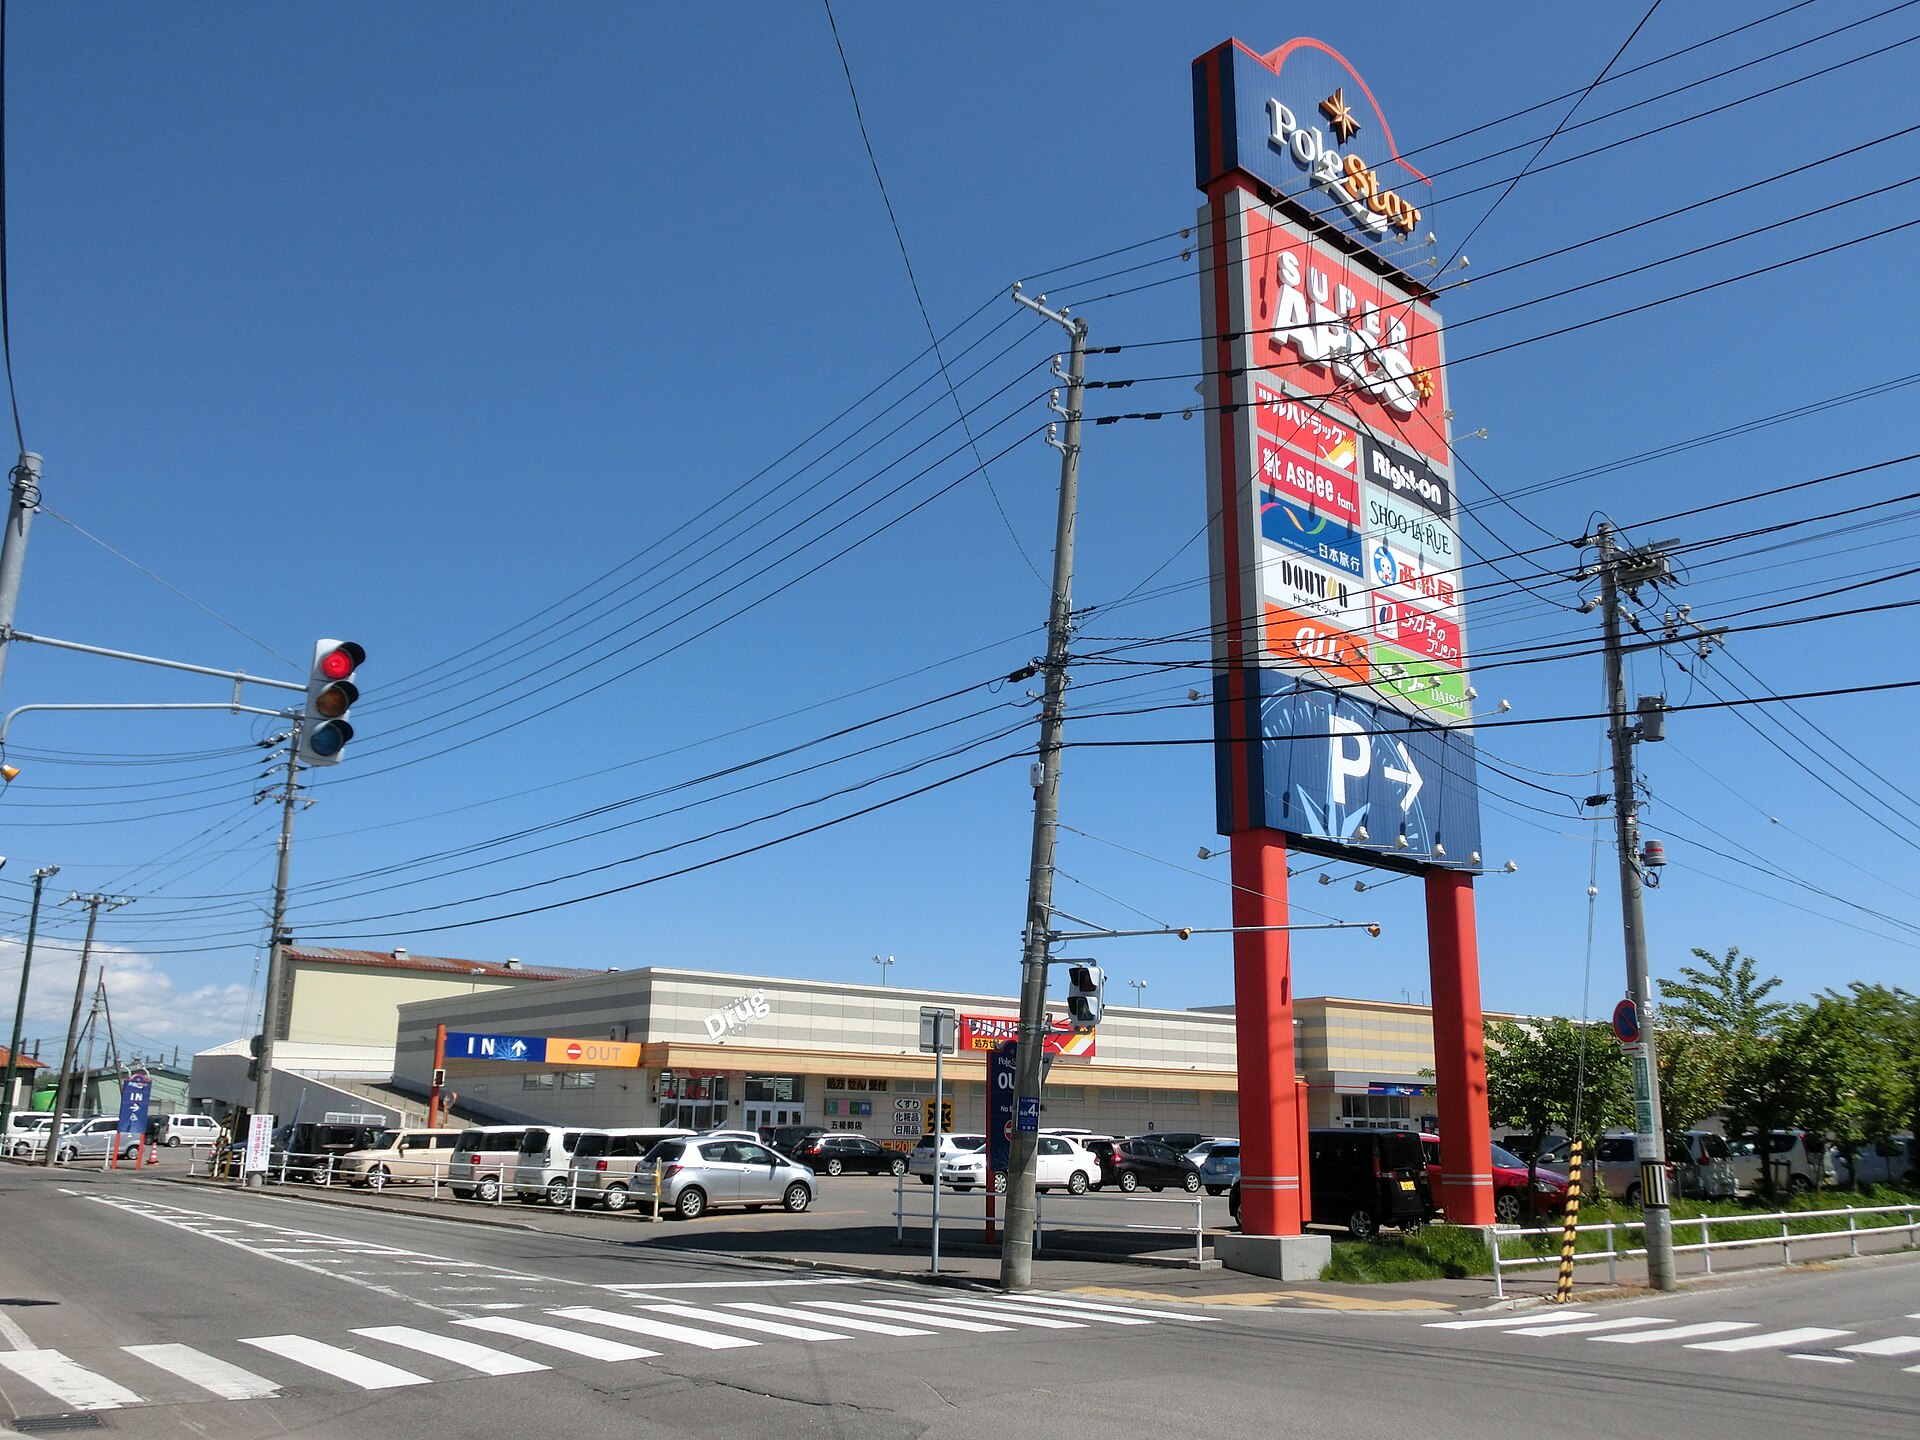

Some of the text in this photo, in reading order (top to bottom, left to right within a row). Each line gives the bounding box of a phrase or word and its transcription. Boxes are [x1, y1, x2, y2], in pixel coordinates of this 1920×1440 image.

[1277, 251, 1408, 353] SUPER
[1269, 284, 1418, 413] ARCS
[1258, 387, 1347, 445] ツルハドラッグ
[1318, 542, 1361, 572] 日本旅行
[1281, 559, 1348, 608] DOUTOR
[1399, 562, 1455, 607] 西松屋
[1400, 610, 1446, 642] メガネの
[1431, 688, 1463, 710] DAISO
[1328, 714, 1372, 805] P
[703, 988, 771, 1041] Drug
[467, 1036, 496, 1056] IN
[586, 1046, 621, 1061] OUT
[998, 1071, 1016, 1090] OU
[130, 1092, 143, 1101] IN
[897, 1099, 920, 1109] くすり
[895, 1112, 919, 1122] 化粧品
[895, 1125, 919, 1136] 日用品
